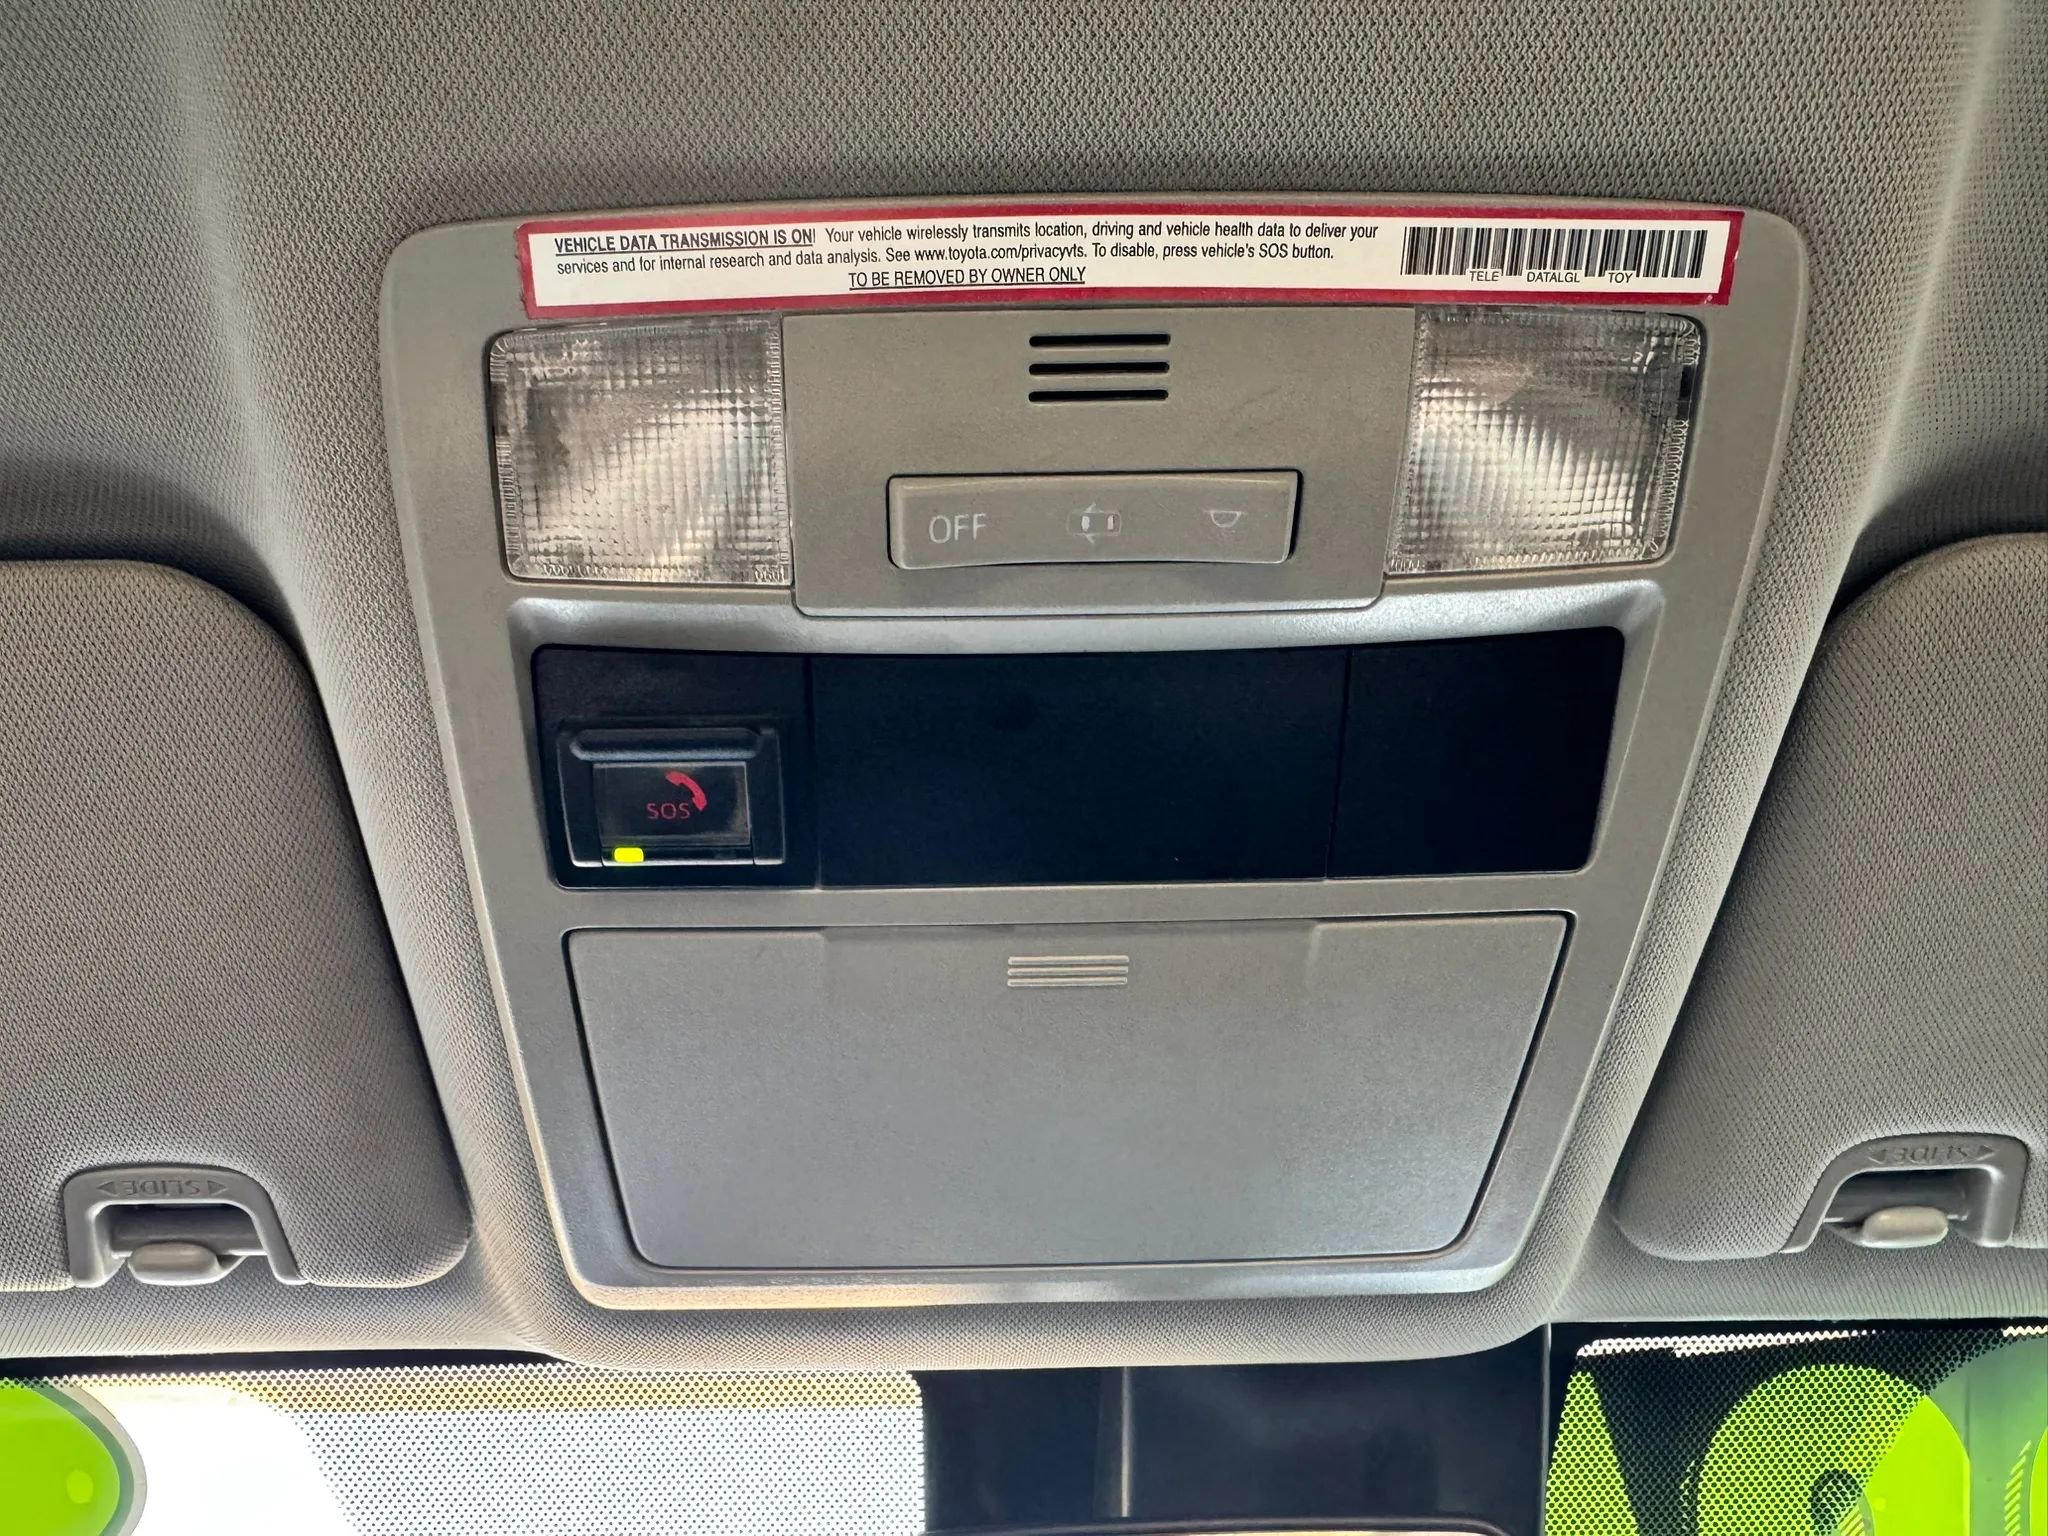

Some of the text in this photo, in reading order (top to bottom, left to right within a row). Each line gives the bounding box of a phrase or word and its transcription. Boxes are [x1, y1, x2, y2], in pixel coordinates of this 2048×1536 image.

[554, 221, 1379, 253] VEHICLE DATA TRANSMISSION IS ON! Your vehicle wirelessly transmits location, driving and vehicle health data to deliver your
[557, 242, 1334, 275] services and for internal research and data analysis. See www.toyota.com/privacyvts. To disable, press vehicle's SOS button.
[848, 266, 1086, 288] TO BE REMOVED BY OWNER ONLY
[1469, 270, 1633, 284] TELE DATALGL TOY
[928, 512, 989, 544] OFF
[646, 802, 691, 820] SOS
[121, 1179, 200, 1197] SLIDE
